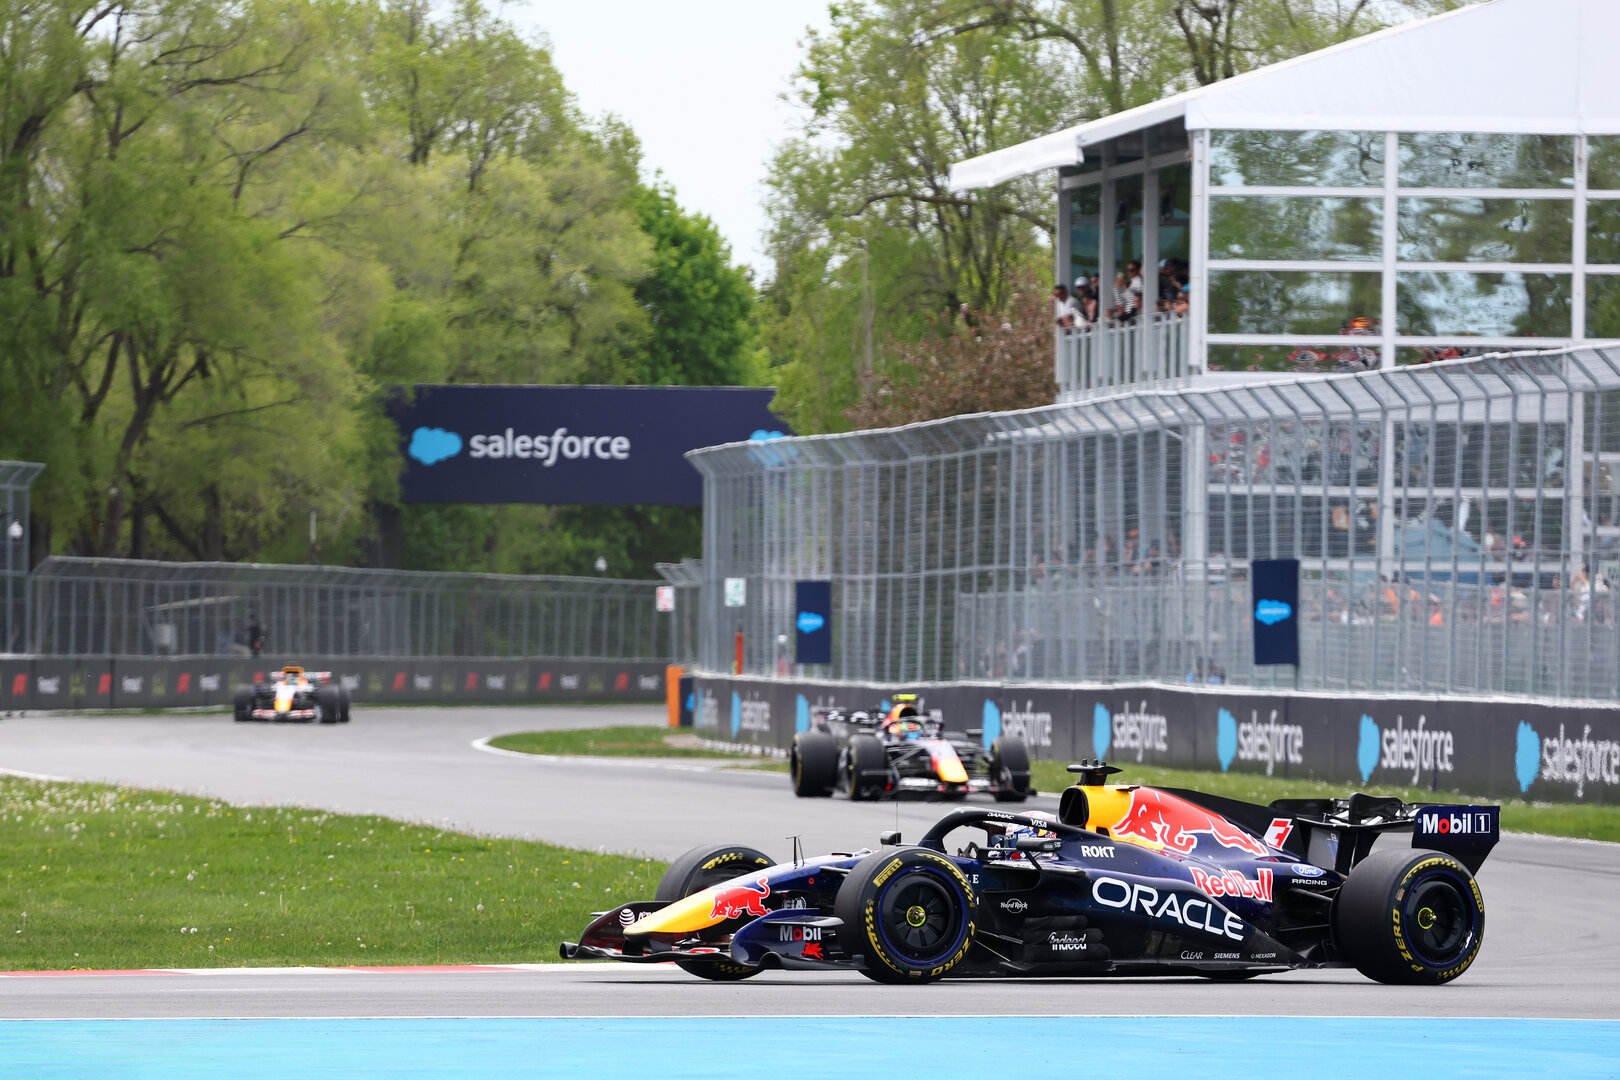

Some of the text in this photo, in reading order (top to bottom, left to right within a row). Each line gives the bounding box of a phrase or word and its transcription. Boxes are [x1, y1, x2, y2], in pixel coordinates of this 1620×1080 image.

[469, 427, 631, 467] salesforce
[1112, 700, 1168, 763] salesforce
[1238, 709, 1304, 777] salesforce
[1381, 714, 1454, 786] salesforce
[1541, 722, 1620, 798] salesforce
[1030, 818, 1048, 828] VISA
[1422, 813, 1472, 834] Mobil
[1081, 845, 1115, 858] ROKT
[1188, 867, 1274, 903] Red Bull
[1292, 878, 1328, 886] RACING
[1092, 876, 1244, 941] ORACLE
[779, 925, 822, 942] Mobil
[1393, 907, 1413, 961] ZERO
[930, 937, 971, 977] ZERO
[1180, 950, 1204, 960] CLEAR
